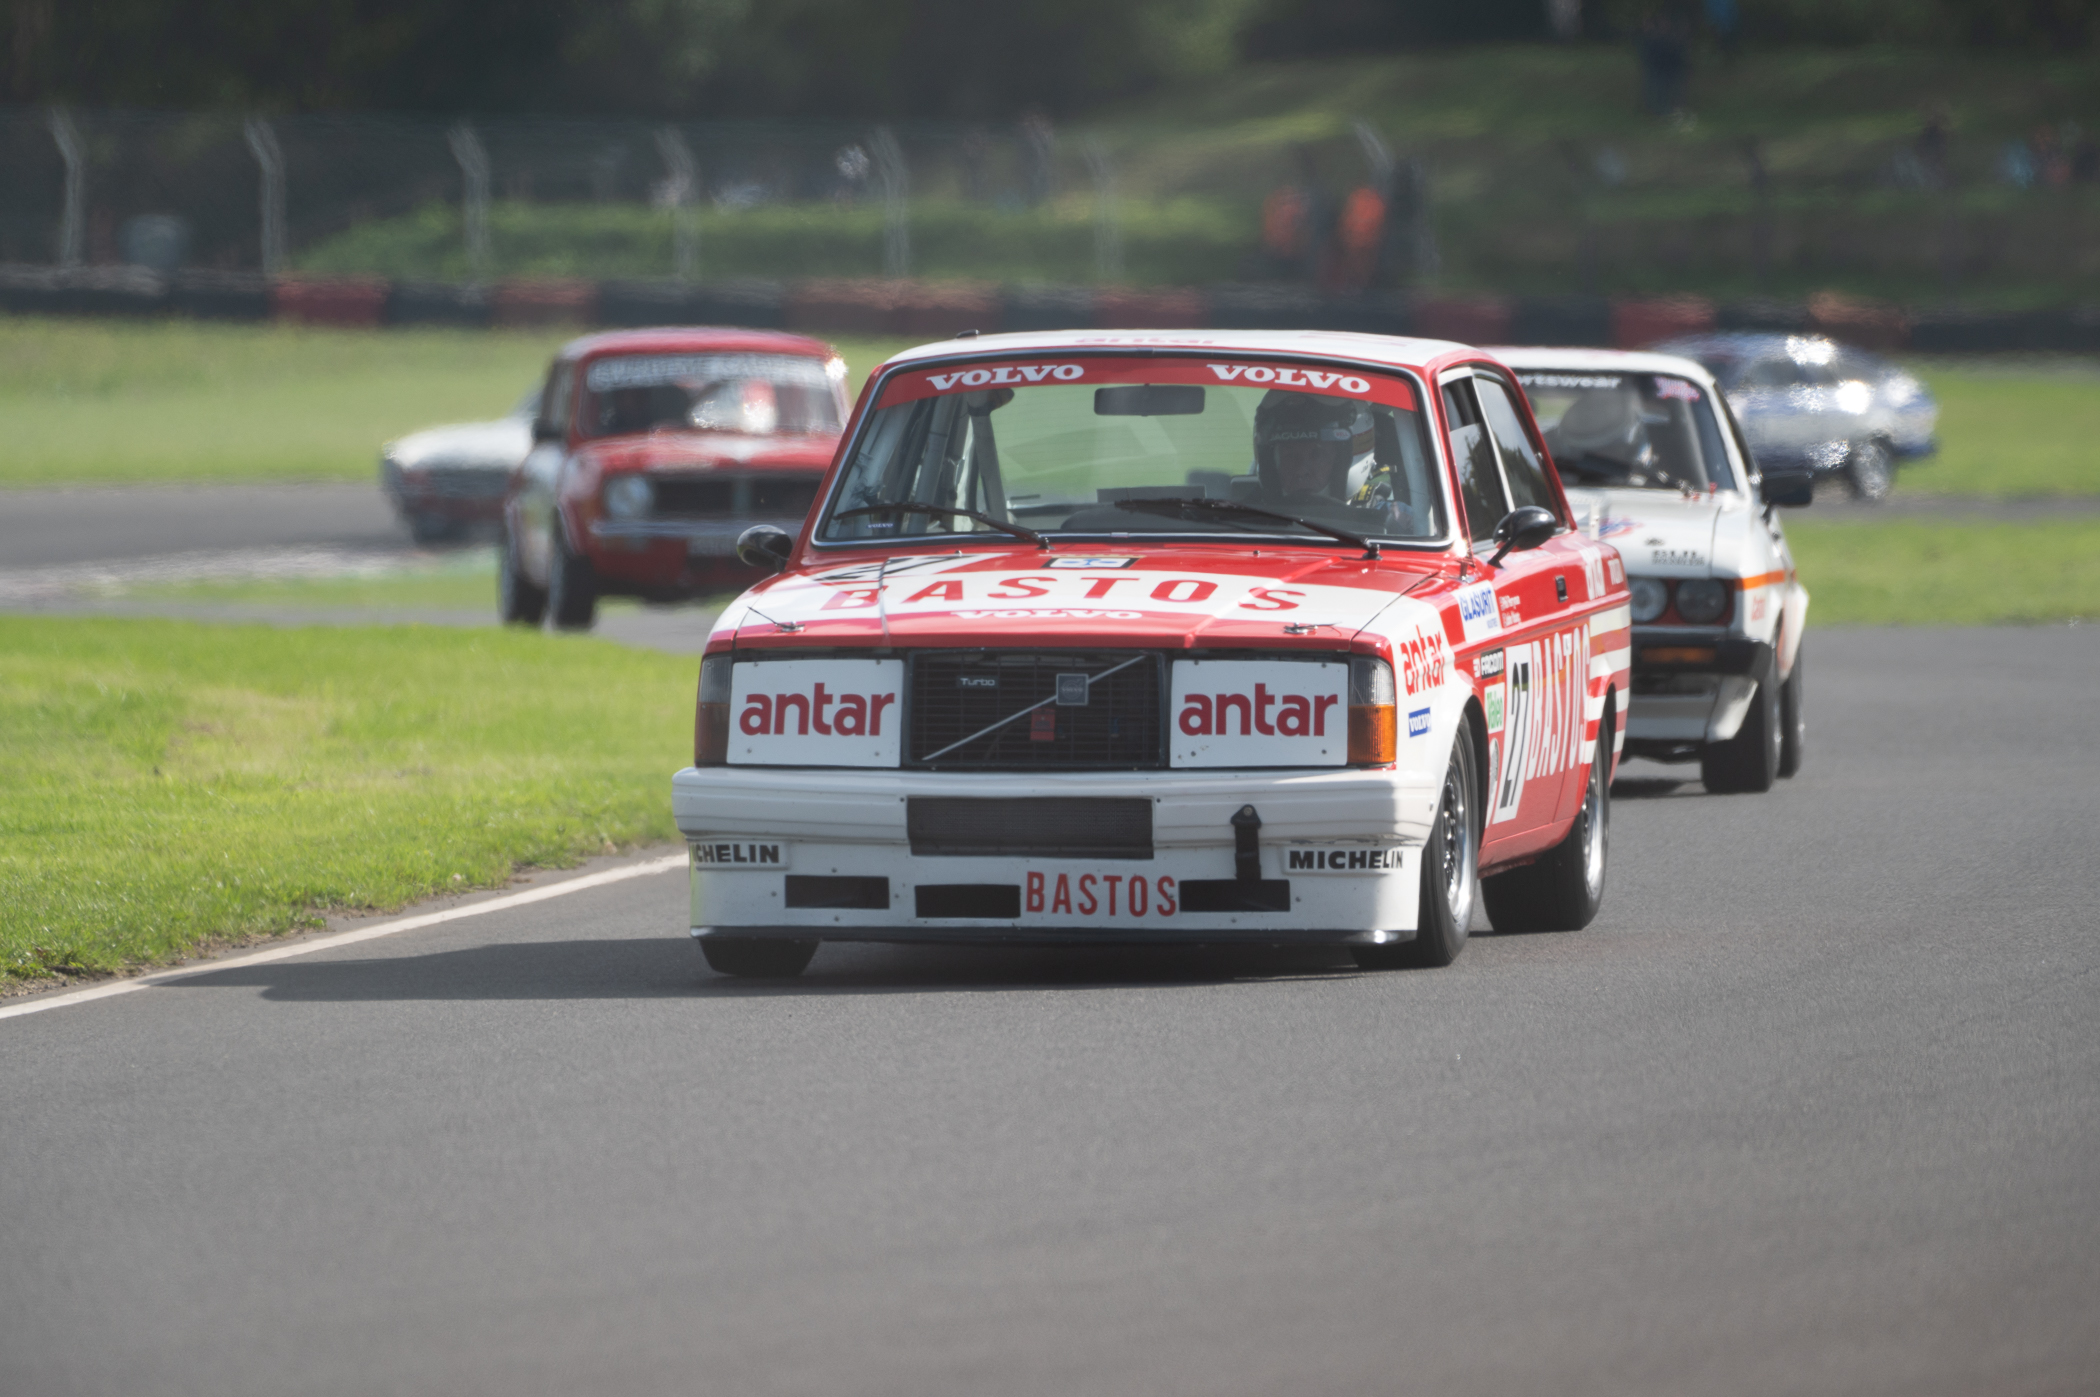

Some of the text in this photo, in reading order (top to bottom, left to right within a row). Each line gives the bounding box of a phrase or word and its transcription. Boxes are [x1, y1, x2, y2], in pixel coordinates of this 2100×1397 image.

[926, 364, 1084, 391] VOLVO
[1206, 364, 1370, 393] VOLVO
[820, 577, 1306, 611] BASTOS
[1459, 587, 1495, 621] GLASURIT
[951, 609, 1142, 619] VOLVO
[1400, 624, 1444, 696] antar
[1481, 651, 1504, 676] FACOM
[960, 678, 995, 687] Turbo
[739, 682, 895, 737] antar
[1178, 682, 1338, 737] antar
[1526, 623, 1590, 781] BASTOS
[1409, 713, 1431, 733] VOLVO
[1499, 661, 1529, 809] 27
[1289, 850, 1403, 869] MICHELIN
[1026, 871, 1176, 917] BASTOS
